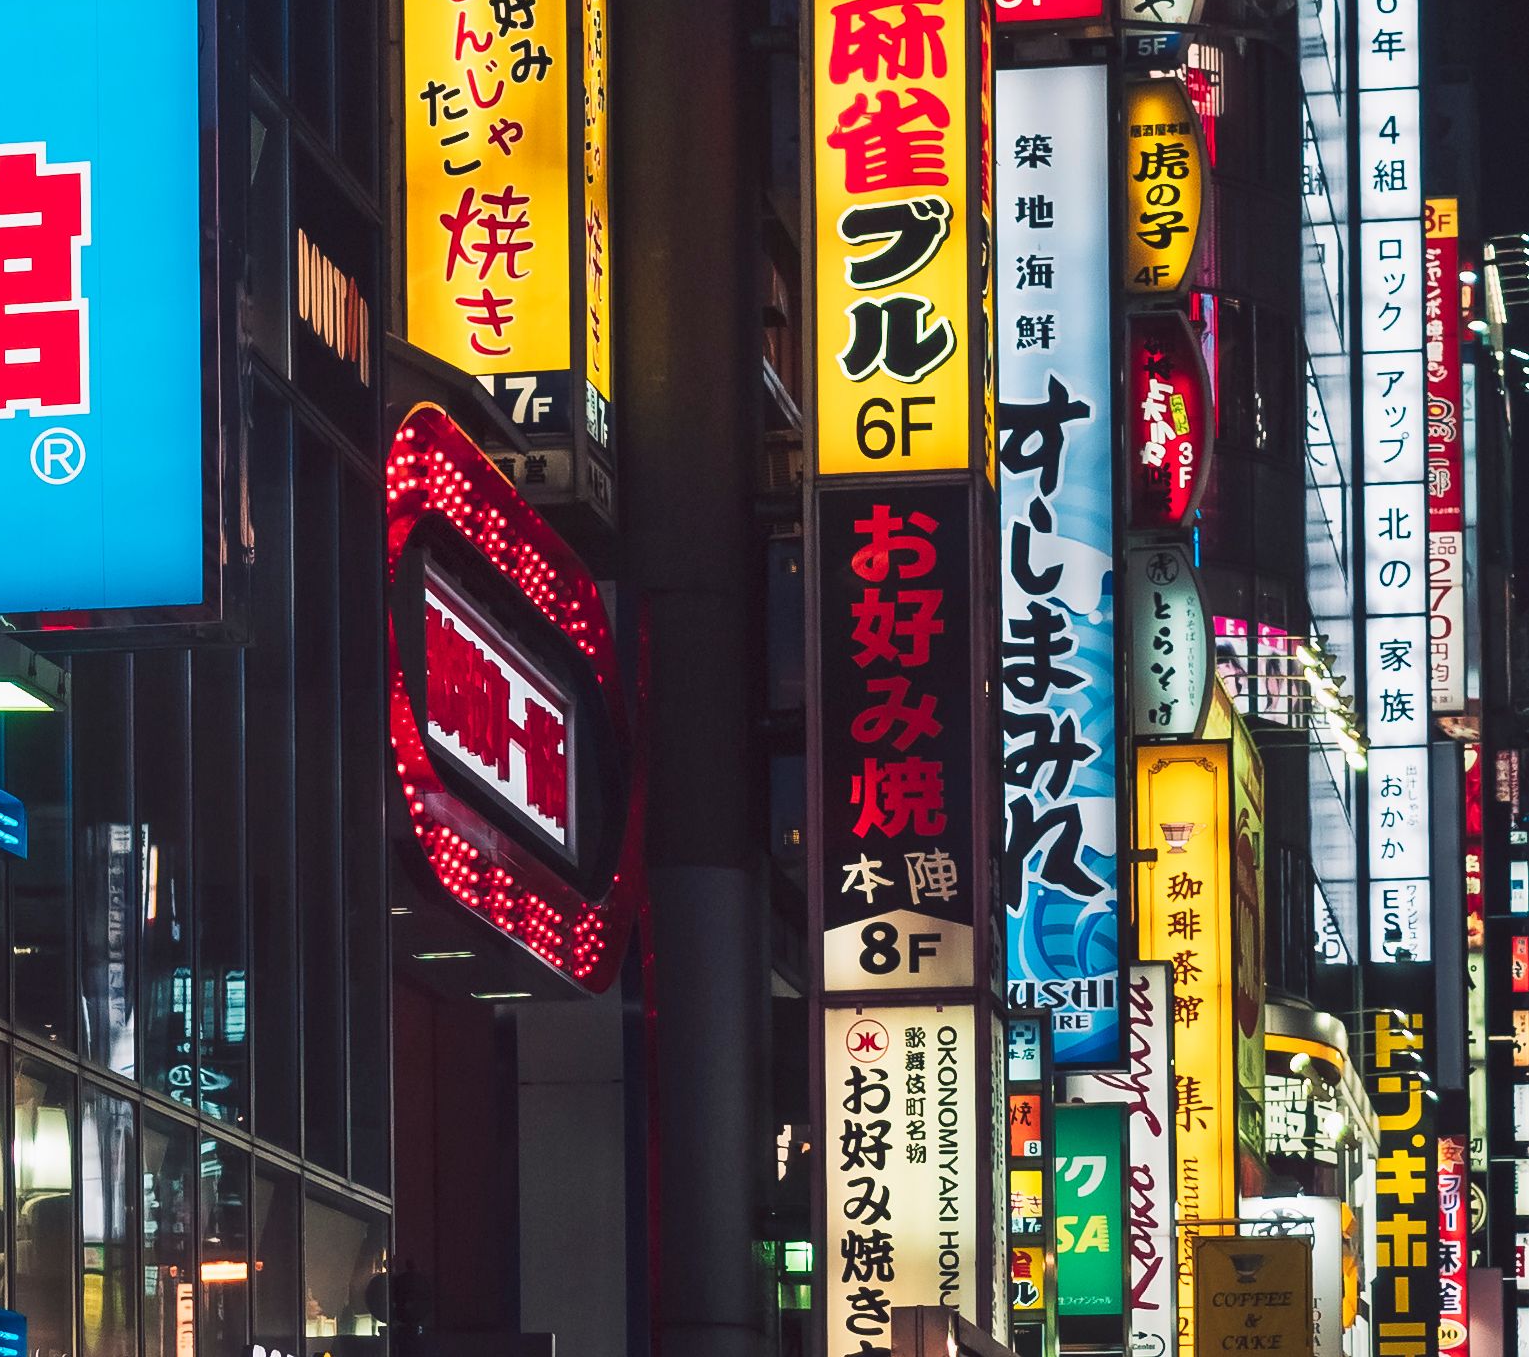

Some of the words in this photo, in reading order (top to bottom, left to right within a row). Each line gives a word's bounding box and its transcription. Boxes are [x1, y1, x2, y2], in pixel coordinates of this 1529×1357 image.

[420, 80, 482, 177] たこ
[1132, 142, 1190, 250] 虎の子
[439, 185, 534, 356] 焼き
[1013, 133, 1056, 351] 築地海鮮
[1134, 264, 1170, 287] 4F
[505, 376, 553, 424] 7F
[856, 396, 936, 459] 6F
[850, 504, 947, 839] お好み焼
[1149, 591, 1179, 726] とらそば
[1380, 772, 1405, 860] おかか
[840, 846, 959, 904] 本陣
[859, 921, 942, 976] 8F
[937, 1025, 959, 1222] OKONOMIYAKI
[1212, 1291, 1293, 1307] COFFEE
[1222, 1334, 1283, 1351] CAKE
